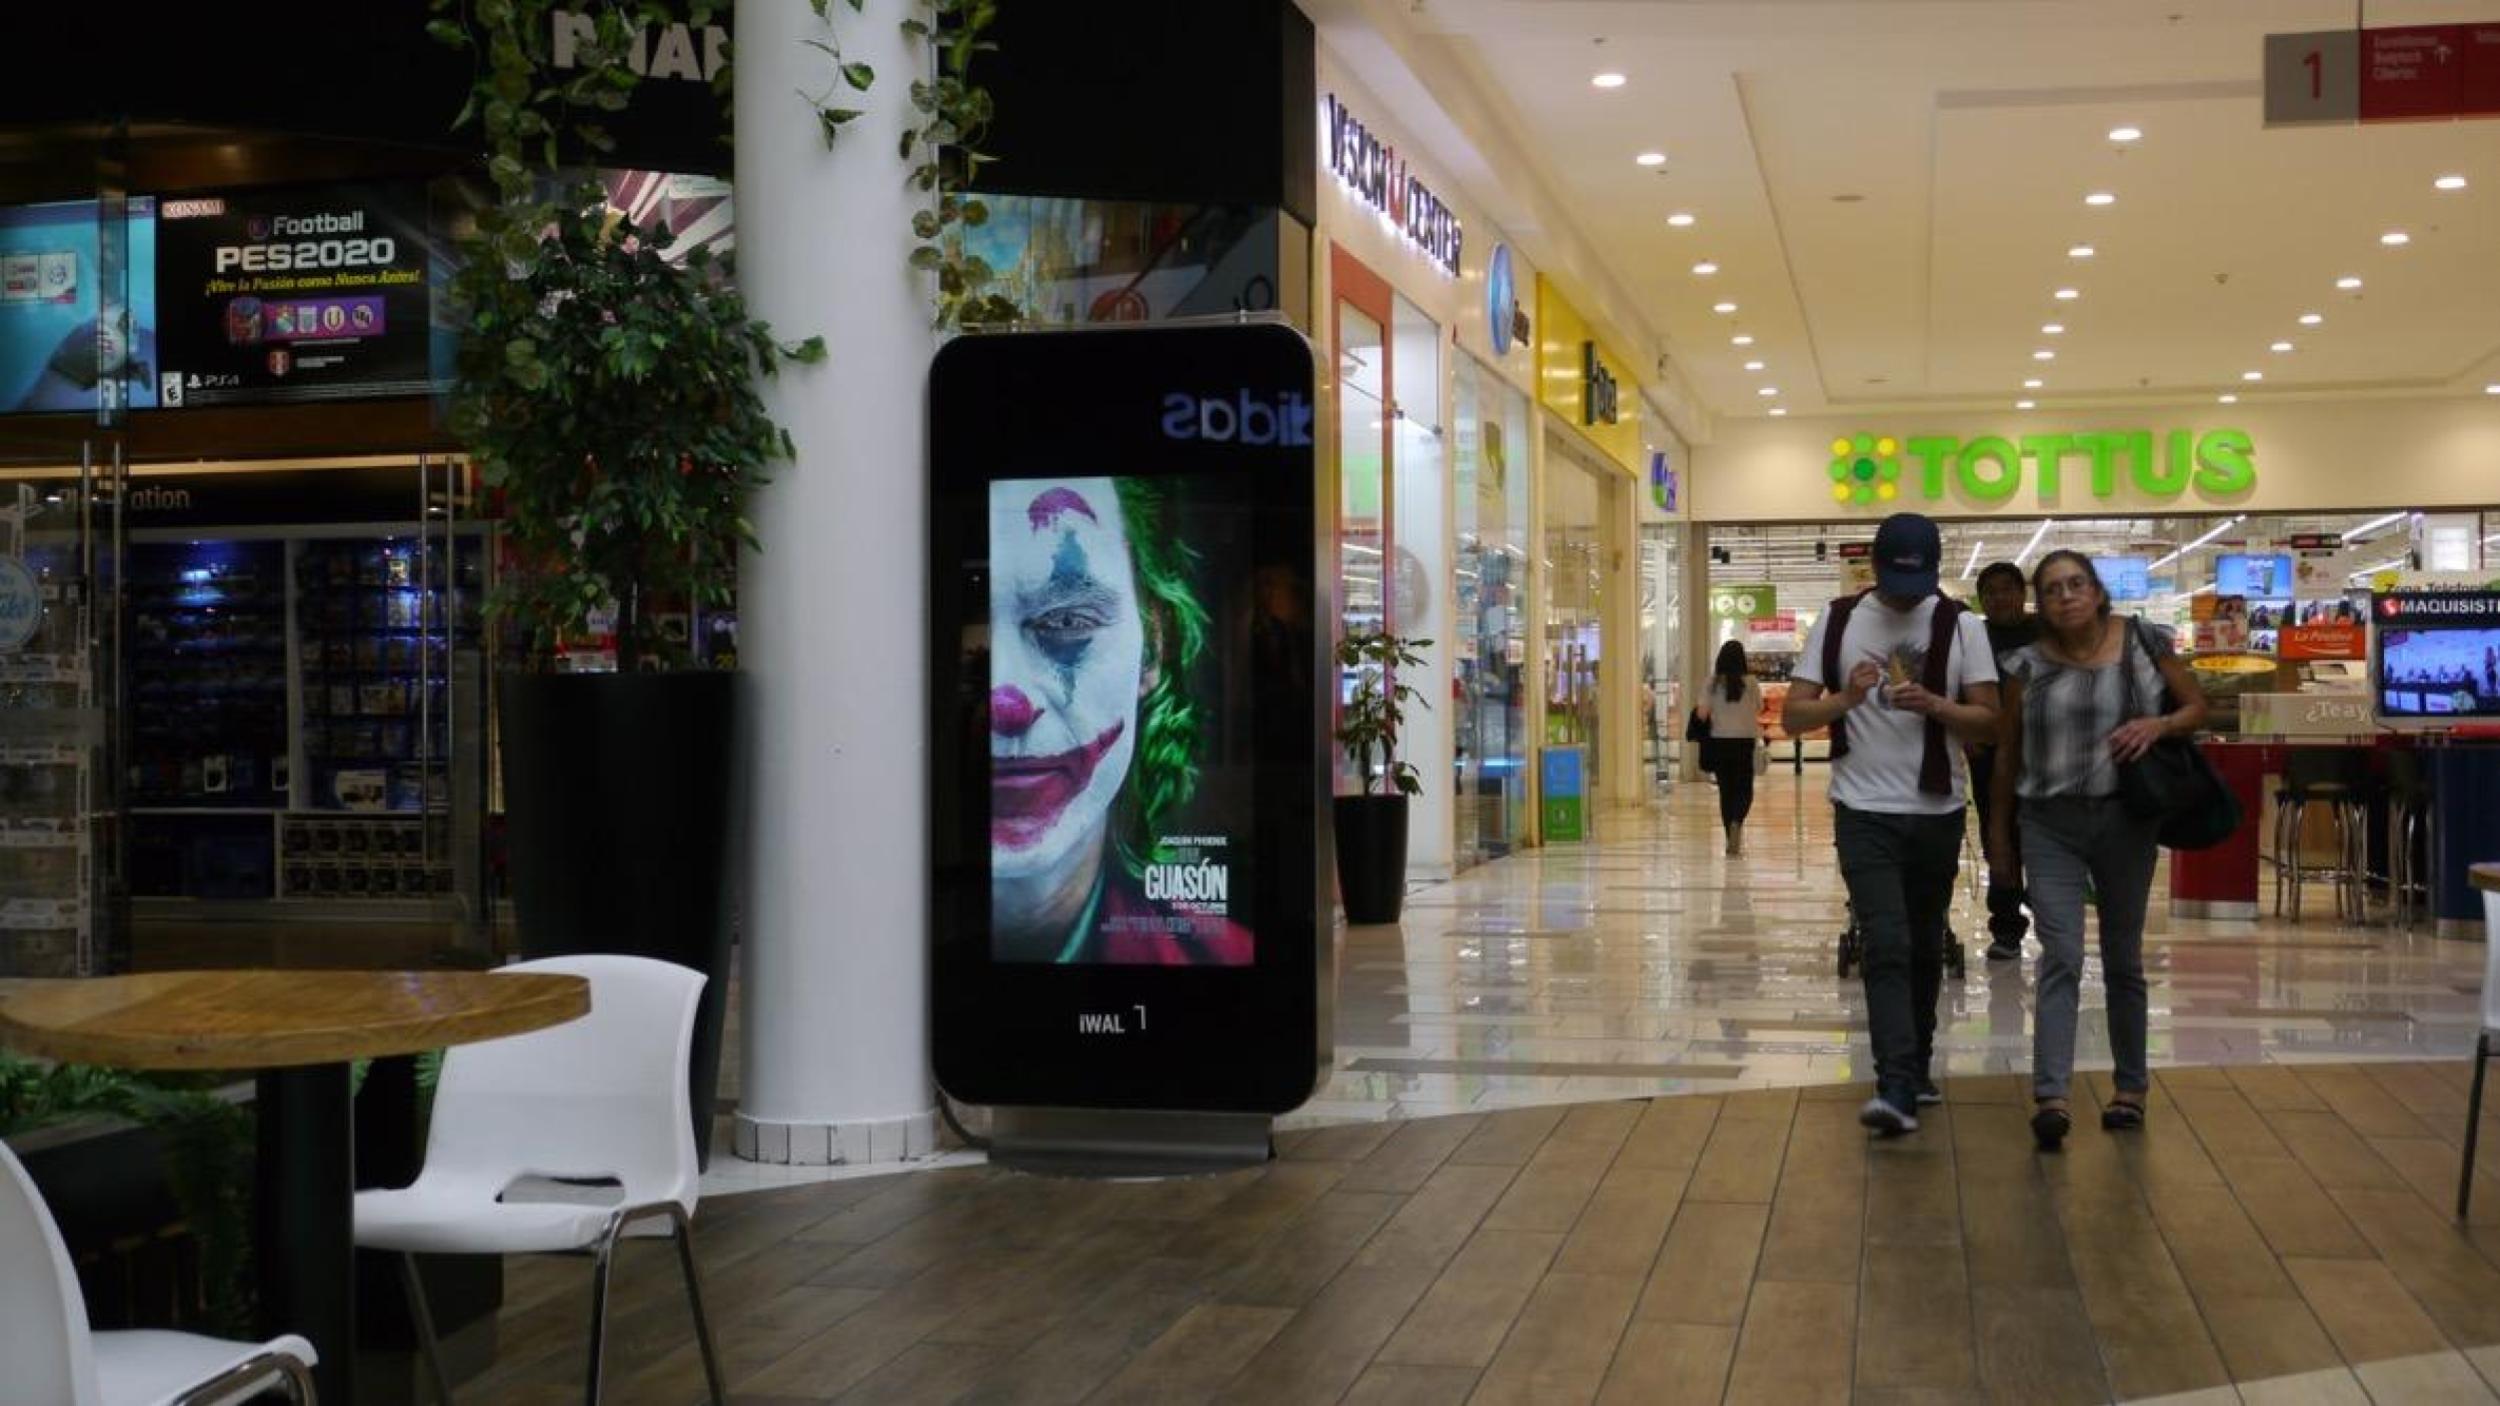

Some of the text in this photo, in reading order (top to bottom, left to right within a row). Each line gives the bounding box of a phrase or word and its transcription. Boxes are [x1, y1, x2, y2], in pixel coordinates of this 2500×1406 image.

[2303, 50, 2322, 99] 1
[1406, 176, 1462, 278] CENTER
[216, 237, 395, 275] PES2020
[1906, 428, 2257, 498] TOTTUS
[1144, 857, 1228, 901] GUASÓN
